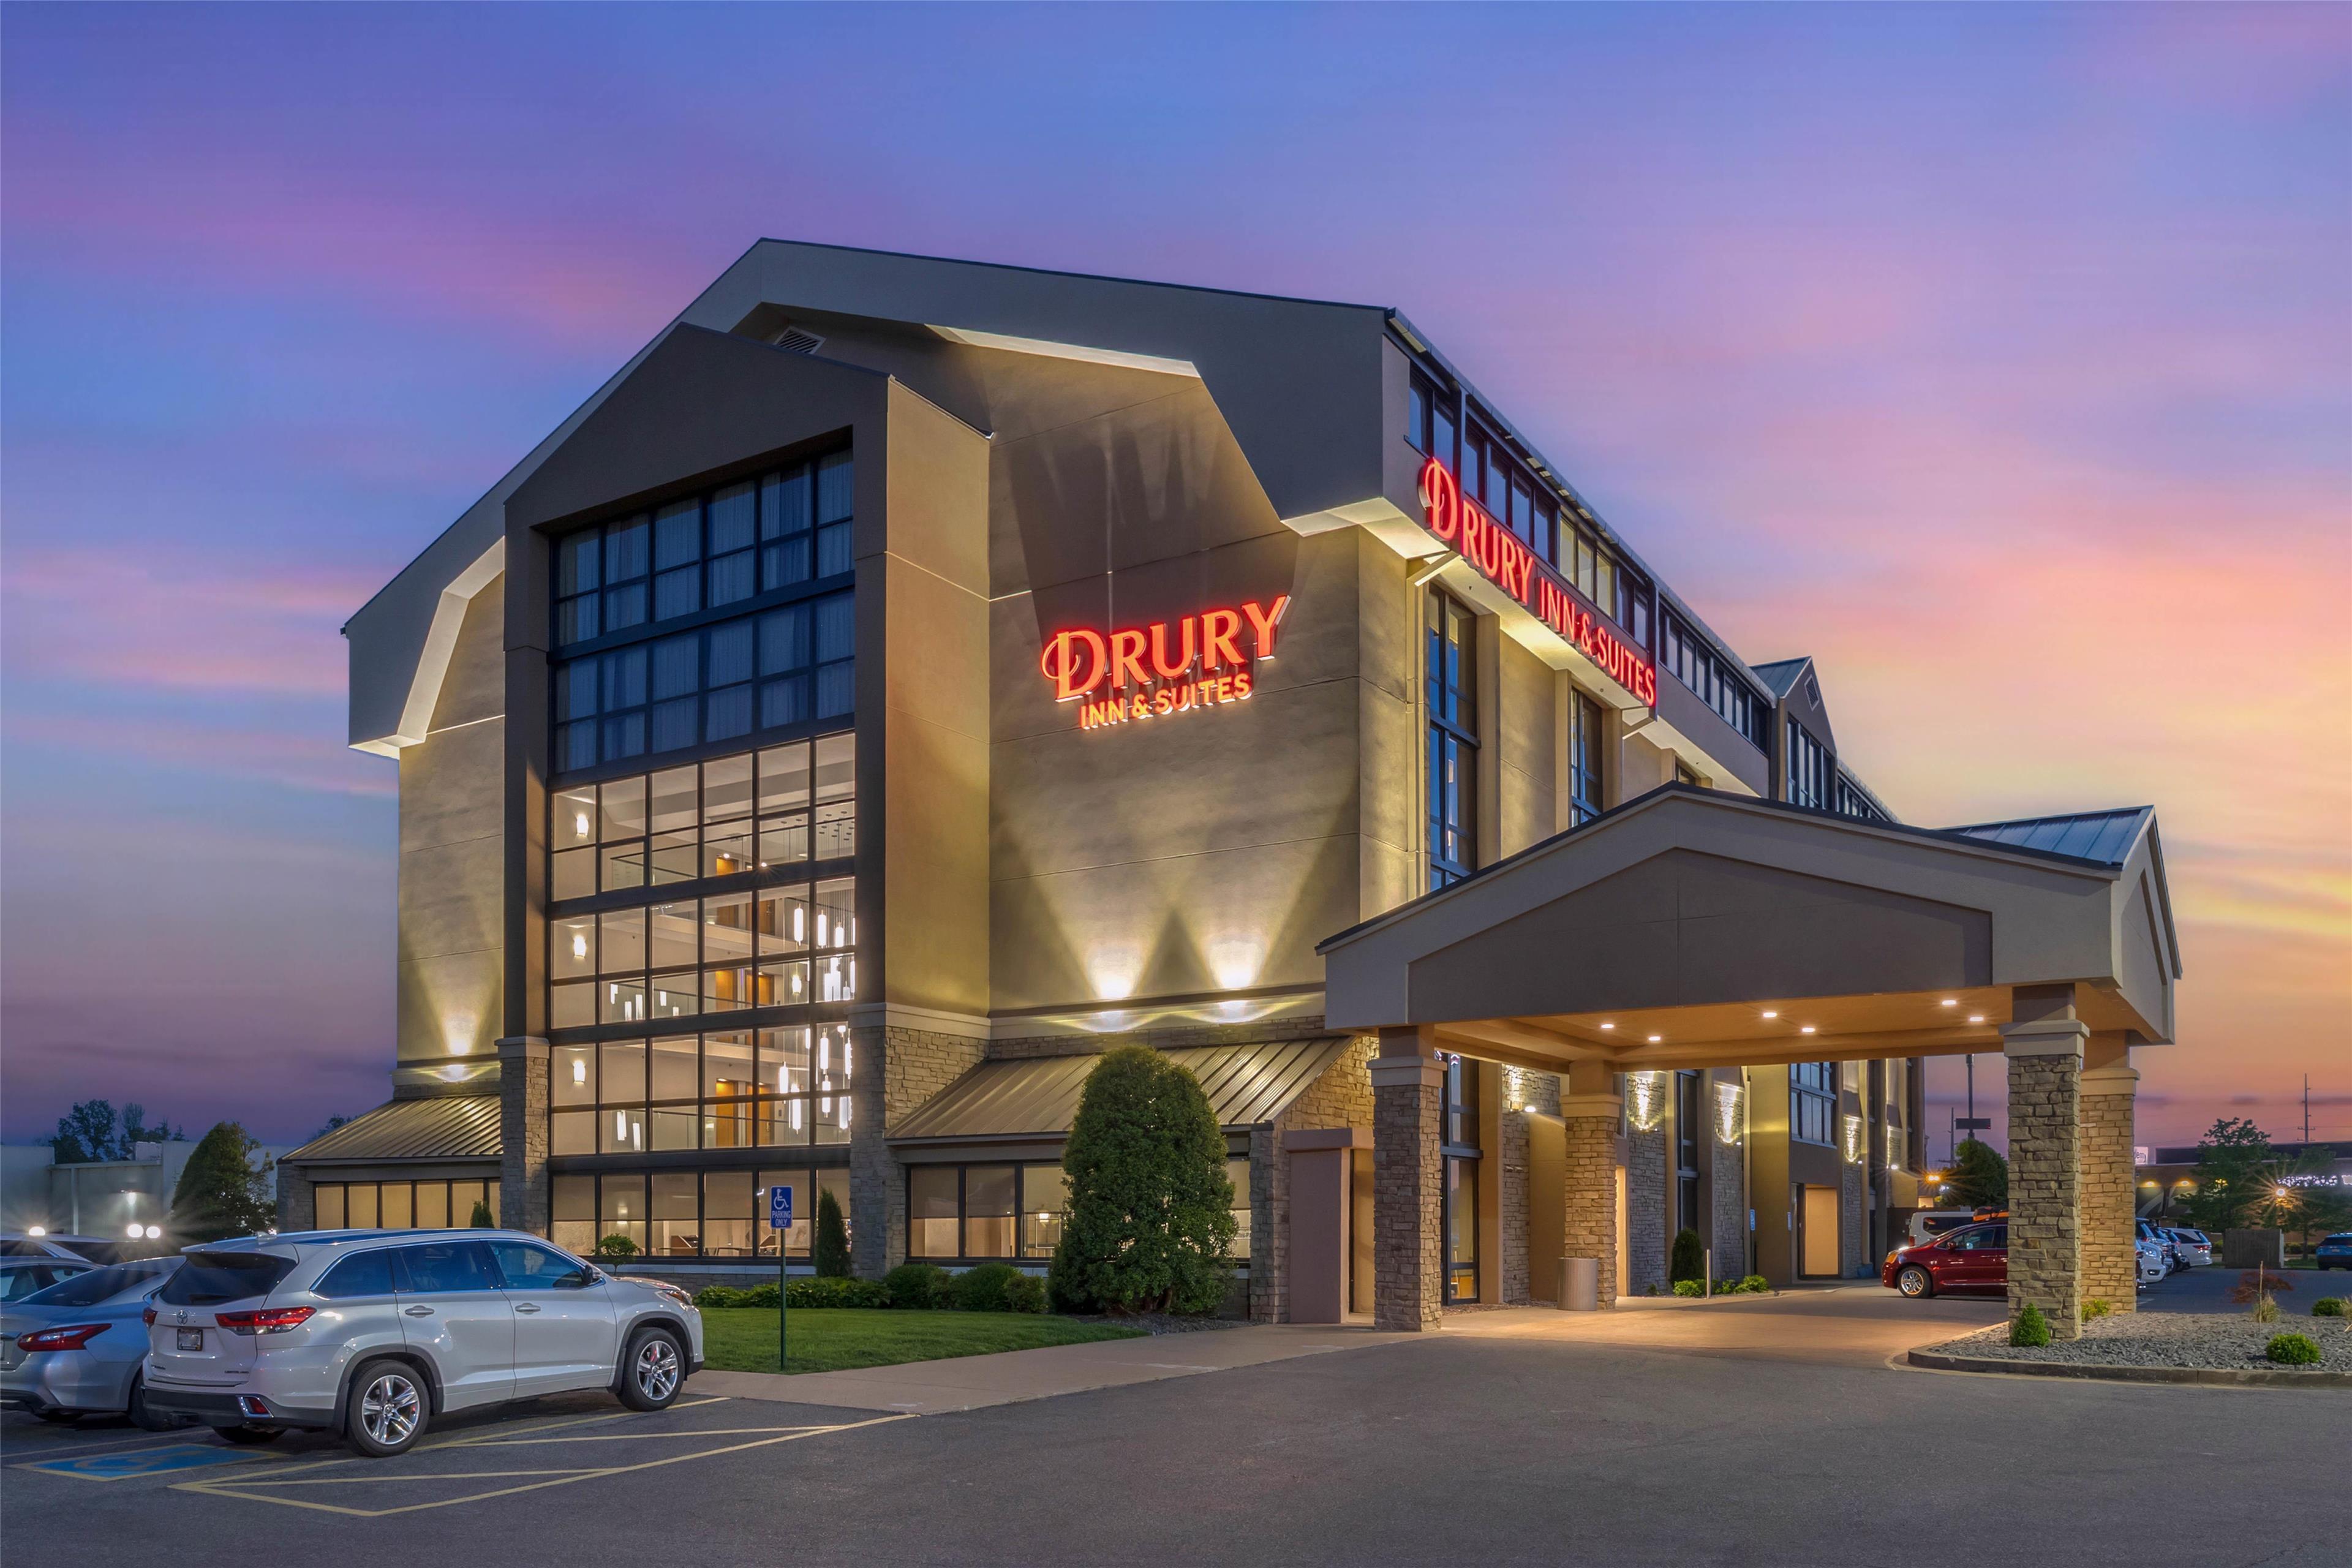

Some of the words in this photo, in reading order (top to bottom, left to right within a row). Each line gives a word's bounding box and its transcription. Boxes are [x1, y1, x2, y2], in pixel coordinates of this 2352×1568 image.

[1422, 458, 1534, 605] DRURY
[1539, 577, 1575, 642] INN
[1580, 612, 1594, 657] &
[1597, 626, 1655, 706] SUITES
[1042, 595, 1289, 701] DRURY
[1080, 698, 1127, 728] INN
[1132, 694, 1152, 718] &
[1155, 673, 1251, 714] SUITES
